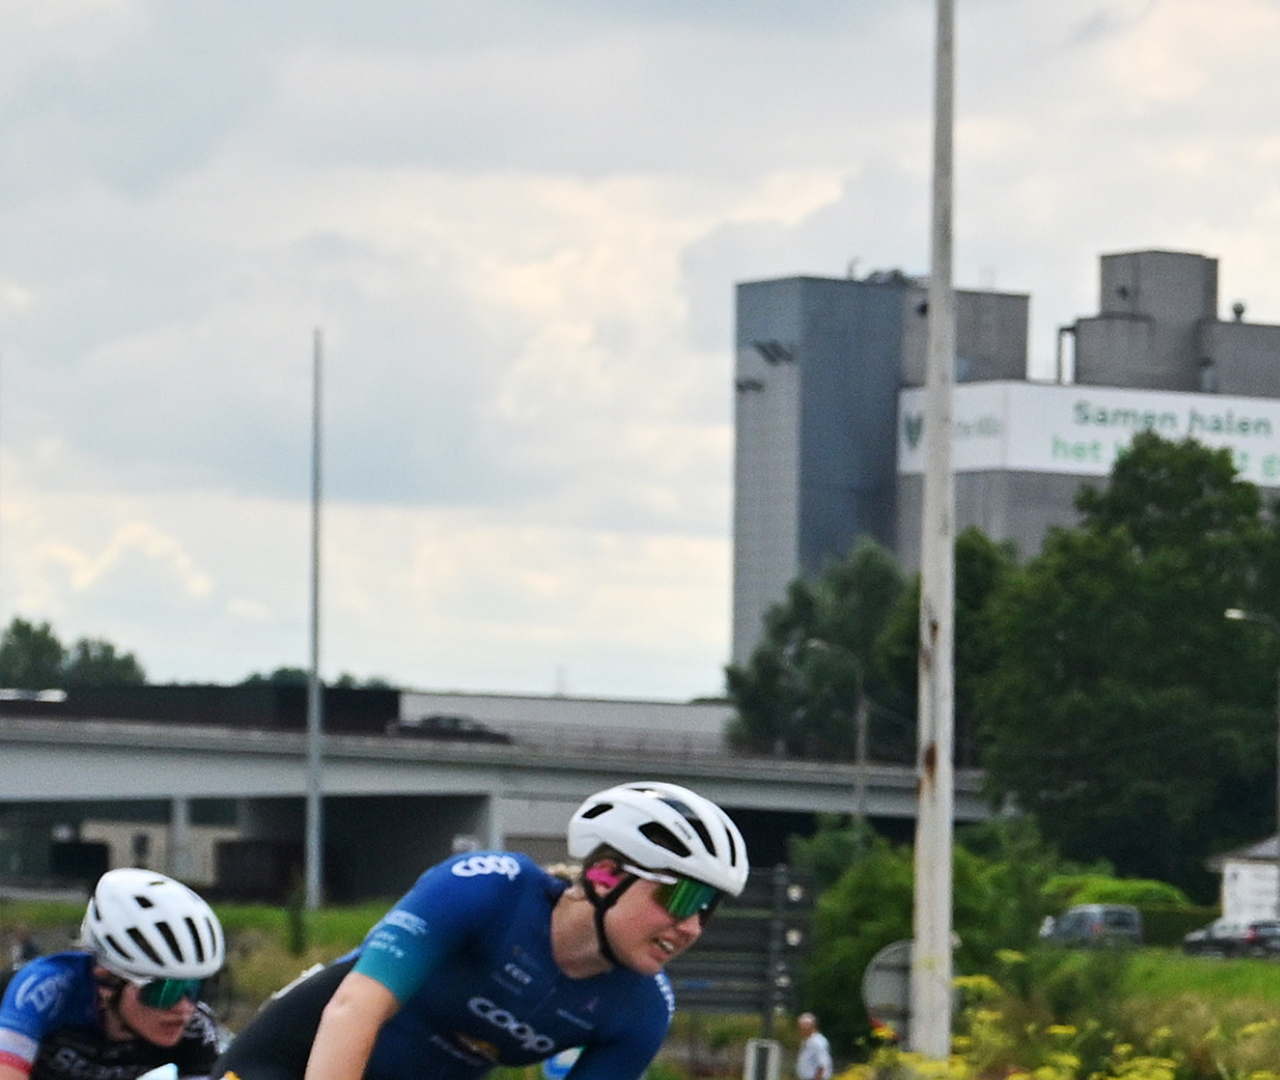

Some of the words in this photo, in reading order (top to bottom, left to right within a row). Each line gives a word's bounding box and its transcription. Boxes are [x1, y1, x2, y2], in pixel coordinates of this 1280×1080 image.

[1074, 400, 1178, 428] Samen
[1188, 407, 1273, 437] halen
[1051, 435, 1101, 461] het
[468, 997, 555, 1053] coop
